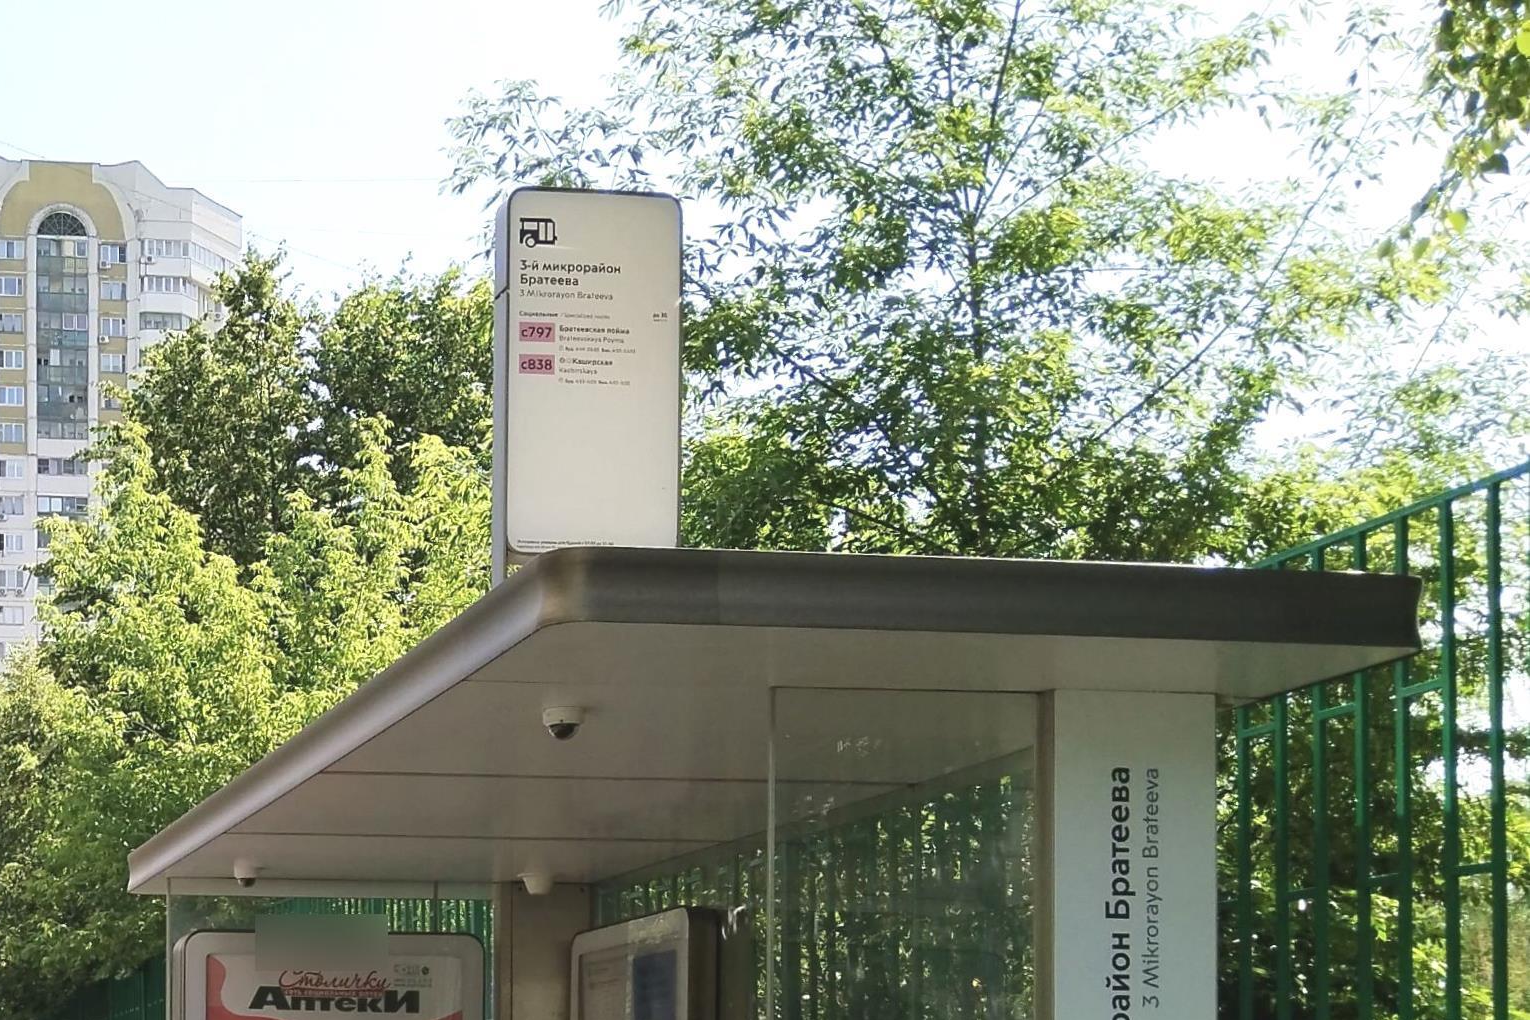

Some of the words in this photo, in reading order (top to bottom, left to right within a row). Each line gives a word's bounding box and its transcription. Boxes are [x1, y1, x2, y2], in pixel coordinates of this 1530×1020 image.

[520, 259, 539, 271] 3-й
[542, 261, 621, 275] микрорайон
[520, 274, 579, 286] Братеева
[520, 289, 525, 297] 3
[527, 290, 575, 300] Mikrorayon
[577, 291, 613, 300] Brateeva
[521, 327, 552, 339] с797
[559, 325, 605, 335] Братеевская
[521, 359, 553, 370] с838
[572, 358, 613, 367] Каширская
[1142, 768, 1159, 858] Brateeva
[1105, 767, 1136, 919] Братеева
[1141, 866, 1163, 988] Mikrorayon
[278, 970, 389, 988] Столички
[1142, 995, 1159, 1008] 3
